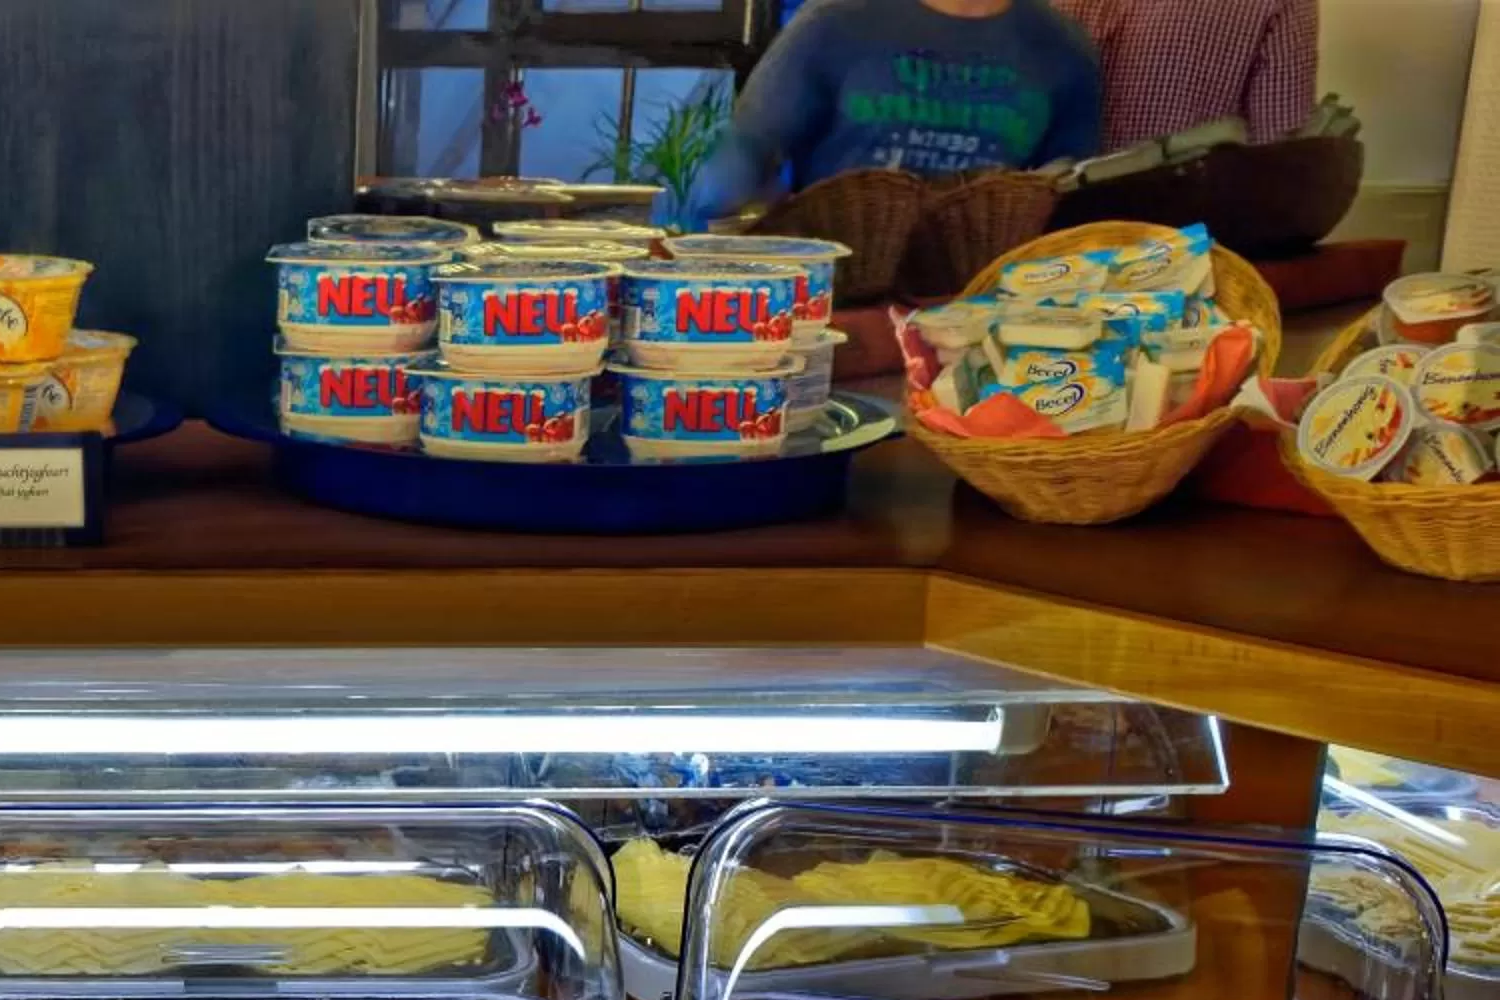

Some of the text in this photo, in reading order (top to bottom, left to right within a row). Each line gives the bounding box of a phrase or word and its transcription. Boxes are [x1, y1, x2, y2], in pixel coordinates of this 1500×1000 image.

[317, 272, 407, 317] NEU
[482, 287, 579, 337] NEU
[675, 287, 771, 333] NEU
[319, 364, 407, 409] NEU
[1035, 391, 1078, 411] Becel
[451, 386, 546, 434] NEU
[662, 388, 758, 433] NEU
